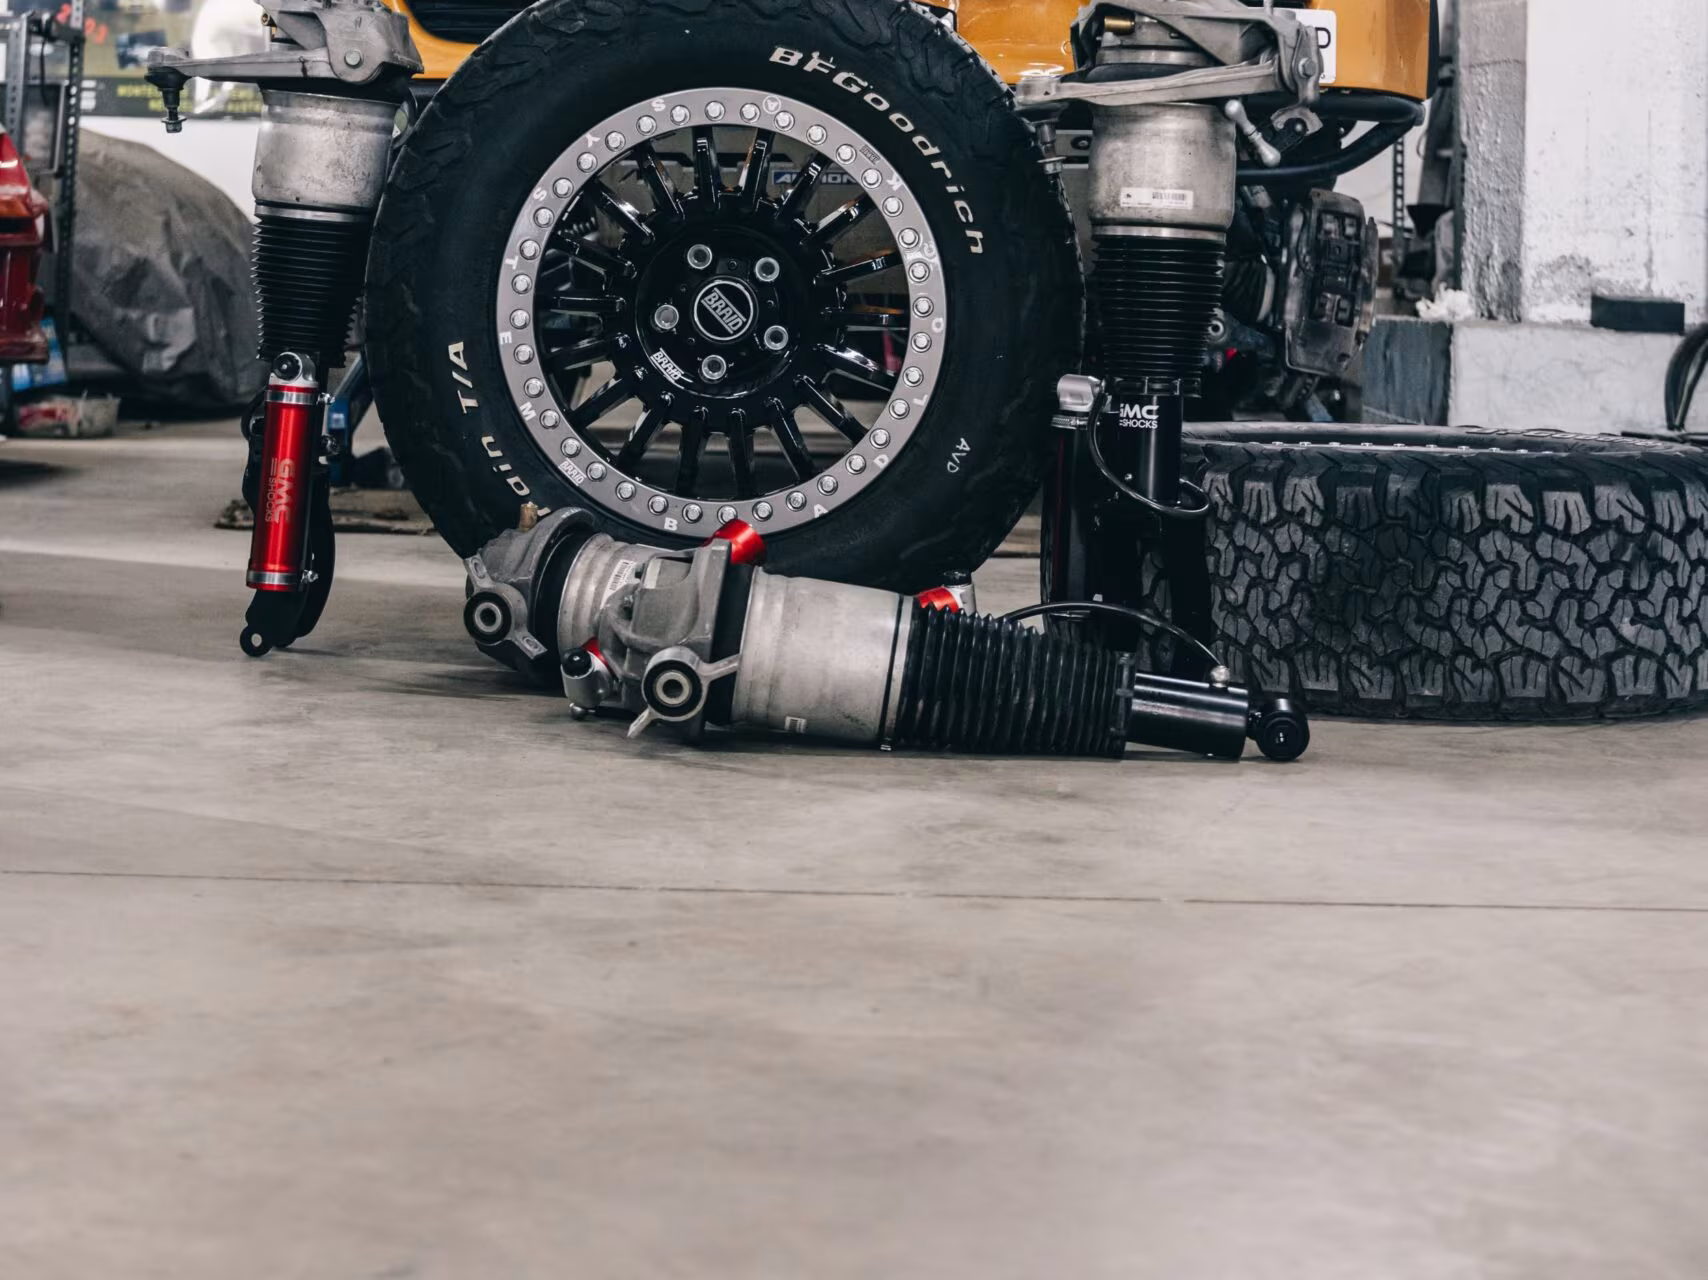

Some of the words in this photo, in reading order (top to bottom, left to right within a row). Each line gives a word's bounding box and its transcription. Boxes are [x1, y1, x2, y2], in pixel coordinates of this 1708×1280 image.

[768, 46, 984, 255] BFGoodrich
[702, 288, 746, 333] BRAID
[447, 341, 480, 415] T/A
[650, 348, 684, 382] BRAID
[1121, 419, 1158, 430] SHOCKS
[558, 458, 587, 487] BRAID
[946, 437, 971, 473] AVD
[264, 477, 276, 523] SHOCKS
[273, 458, 296, 524] GMC
